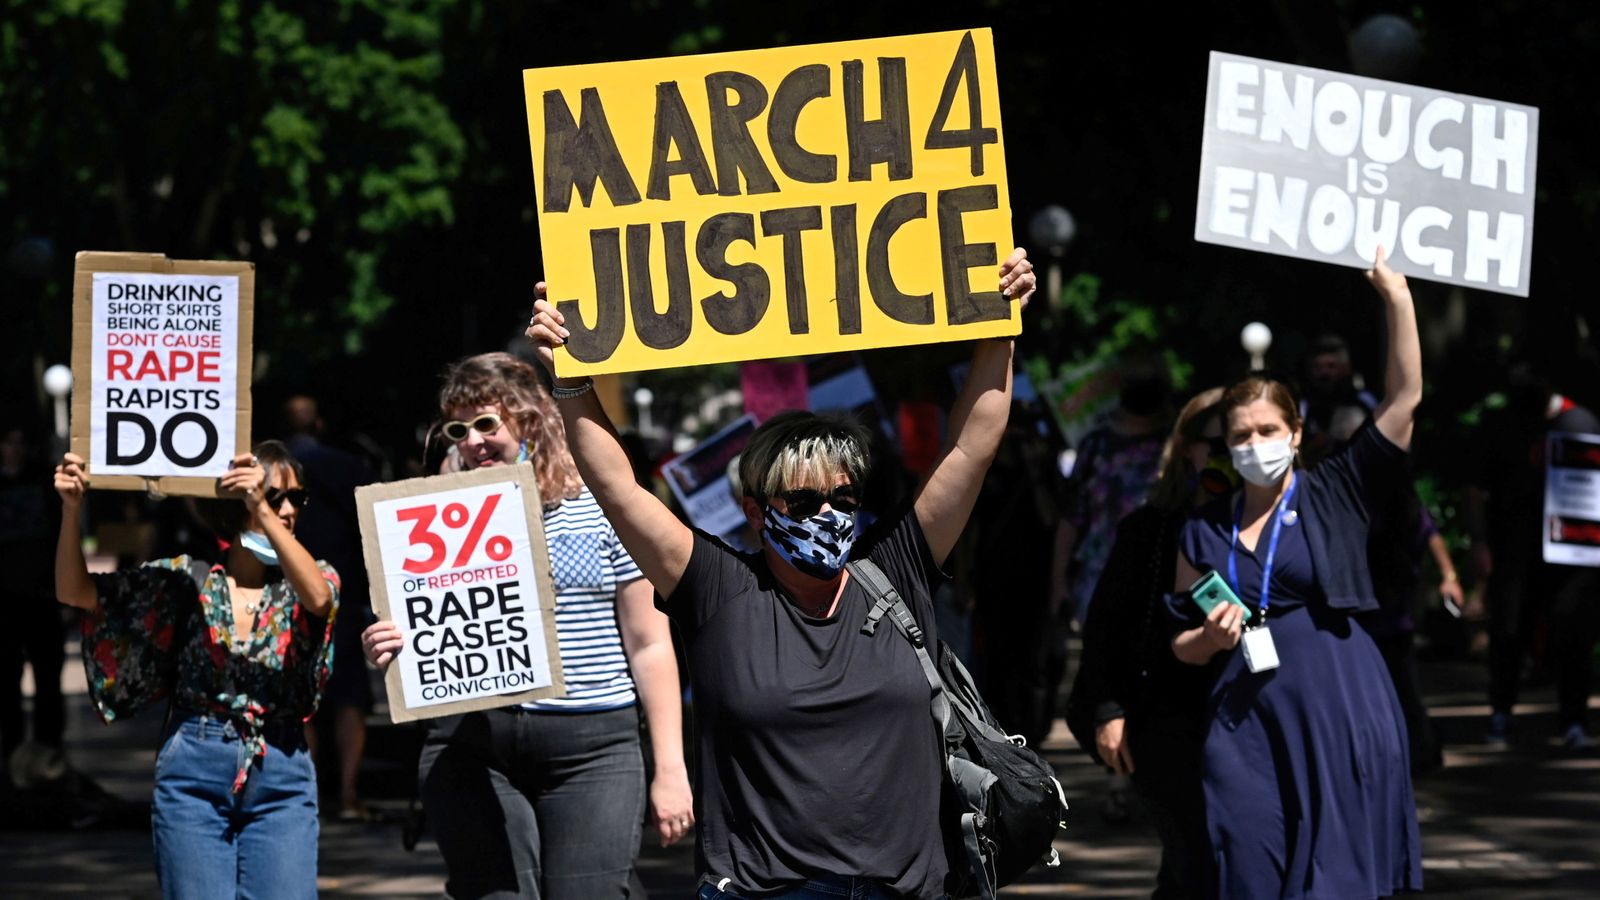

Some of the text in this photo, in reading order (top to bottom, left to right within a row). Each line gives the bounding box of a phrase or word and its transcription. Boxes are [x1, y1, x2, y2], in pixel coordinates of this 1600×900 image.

[543, 31, 997, 213] MARCH 4
[1217, 61, 1528, 194] ENOUGH
[1348, 157, 1389, 194] IS
[1209, 166, 1525, 288] ENOUGH
[108, 283, 222, 302] DRINKING
[555, 184, 1011, 363] JUSTICE
[107, 318, 221, 331] BEING ALONE
[108, 303, 221, 317] SHORT SKIRTS
[107, 333, 221, 348] DONT CAUSE
[107, 350, 220, 382] RAPE
[107, 388, 220, 410] RAPISTS
[106, 412, 219, 467] DO
[396, 494, 513, 574] 3%
[403, 564, 518, 593] OF REPORTED
[406, 581, 524, 630] RAPE
[413, 616, 528, 657] CASES
[417, 645, 532, 685] END IN
[422, 671, 534, 700] CONVICTION
